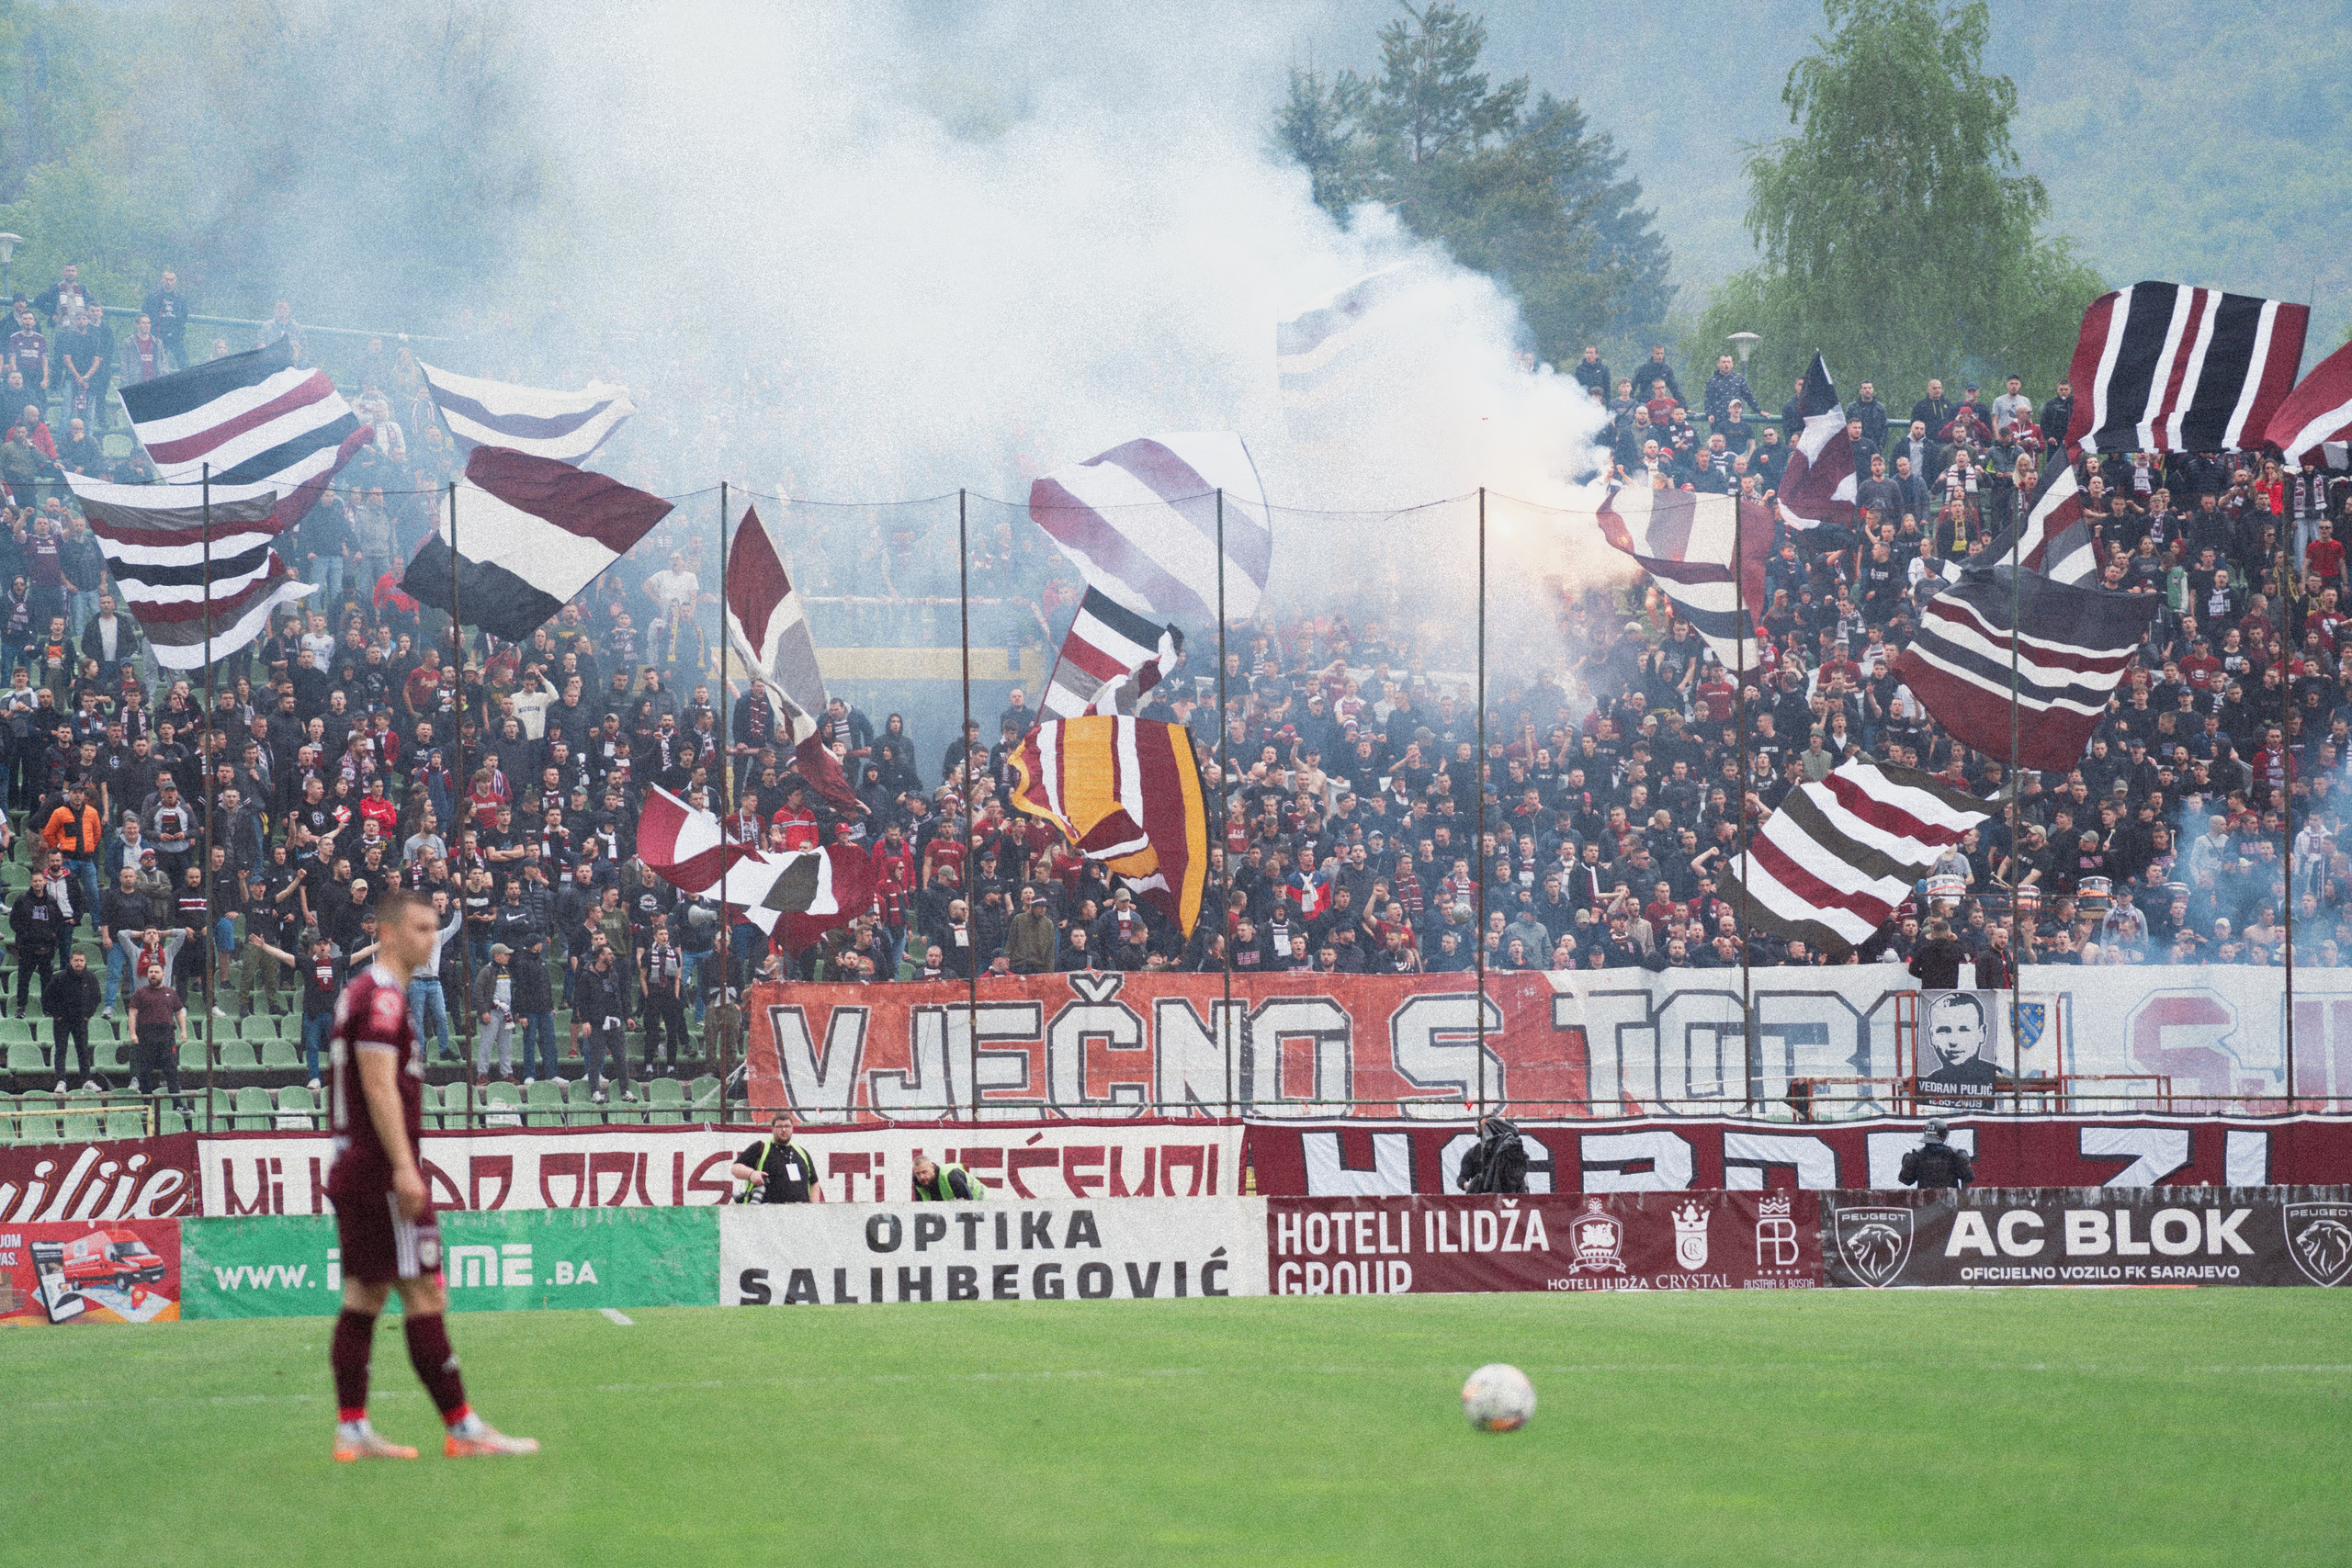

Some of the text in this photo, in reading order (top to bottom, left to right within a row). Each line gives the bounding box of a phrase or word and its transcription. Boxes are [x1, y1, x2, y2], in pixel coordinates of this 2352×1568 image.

[768, 972, 1353, 1120] VJEČNO
[1387, 993, 1509, 1119] S
[1918, 1080, 1993, 1097] VEDRAN PULJIĆ
[1277, 1198, 1550, 1256] HOTELI ILIDŽA
[1841, 1213, 1906, 1222] PEUGEOT
[865, 1209, 1102, 1254] OPTIKA
[1944, 1207, 2256, 1258] AC BLOK
[739, 1246, 1229, 1305] SALIHBEGOVIĆ
[1277, 1260, 1413, 1295] GROUP
[1547, 1275, 1649, 1291] HOTELI ILIDŽA
[1656, 1274, 1732, 1289] CRYSTAL
[1744, 1279, 1777, 1290] AUSTRIA
[1960, 1265, 2241, 1280] OFICIJELNO VOZILO FK SARAJEVO
